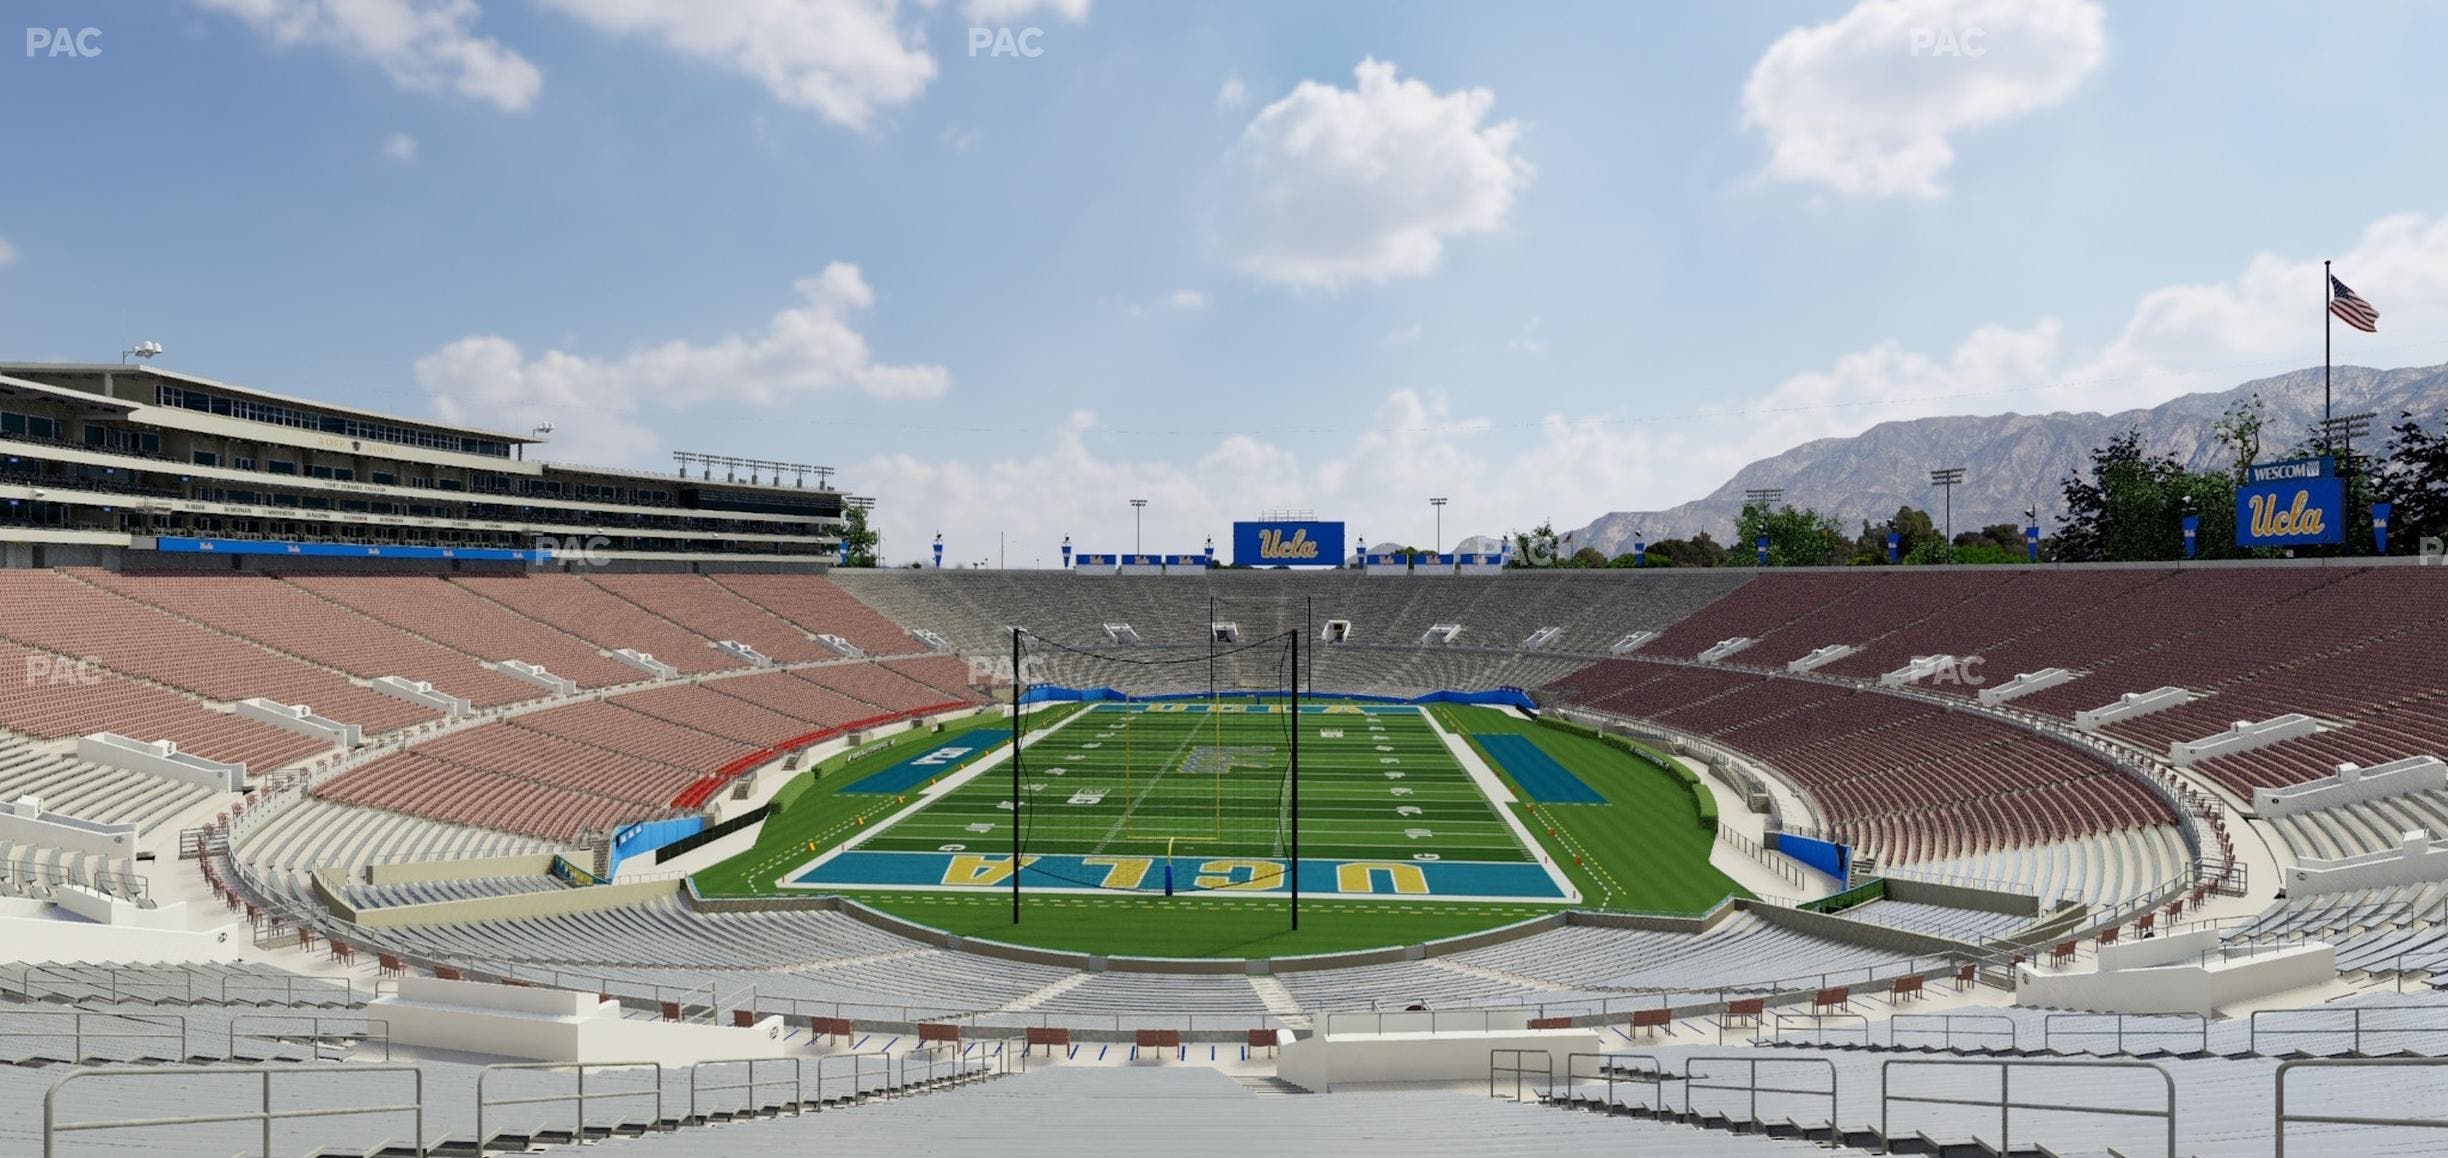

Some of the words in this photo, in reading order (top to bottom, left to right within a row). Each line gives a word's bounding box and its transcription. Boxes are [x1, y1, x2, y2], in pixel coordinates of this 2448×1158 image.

[2254, 464, 2306, 481] WESCOM
[2248, 490, 2325, 537] Ucla
[1259, 528, 1319, 558] Ucla
